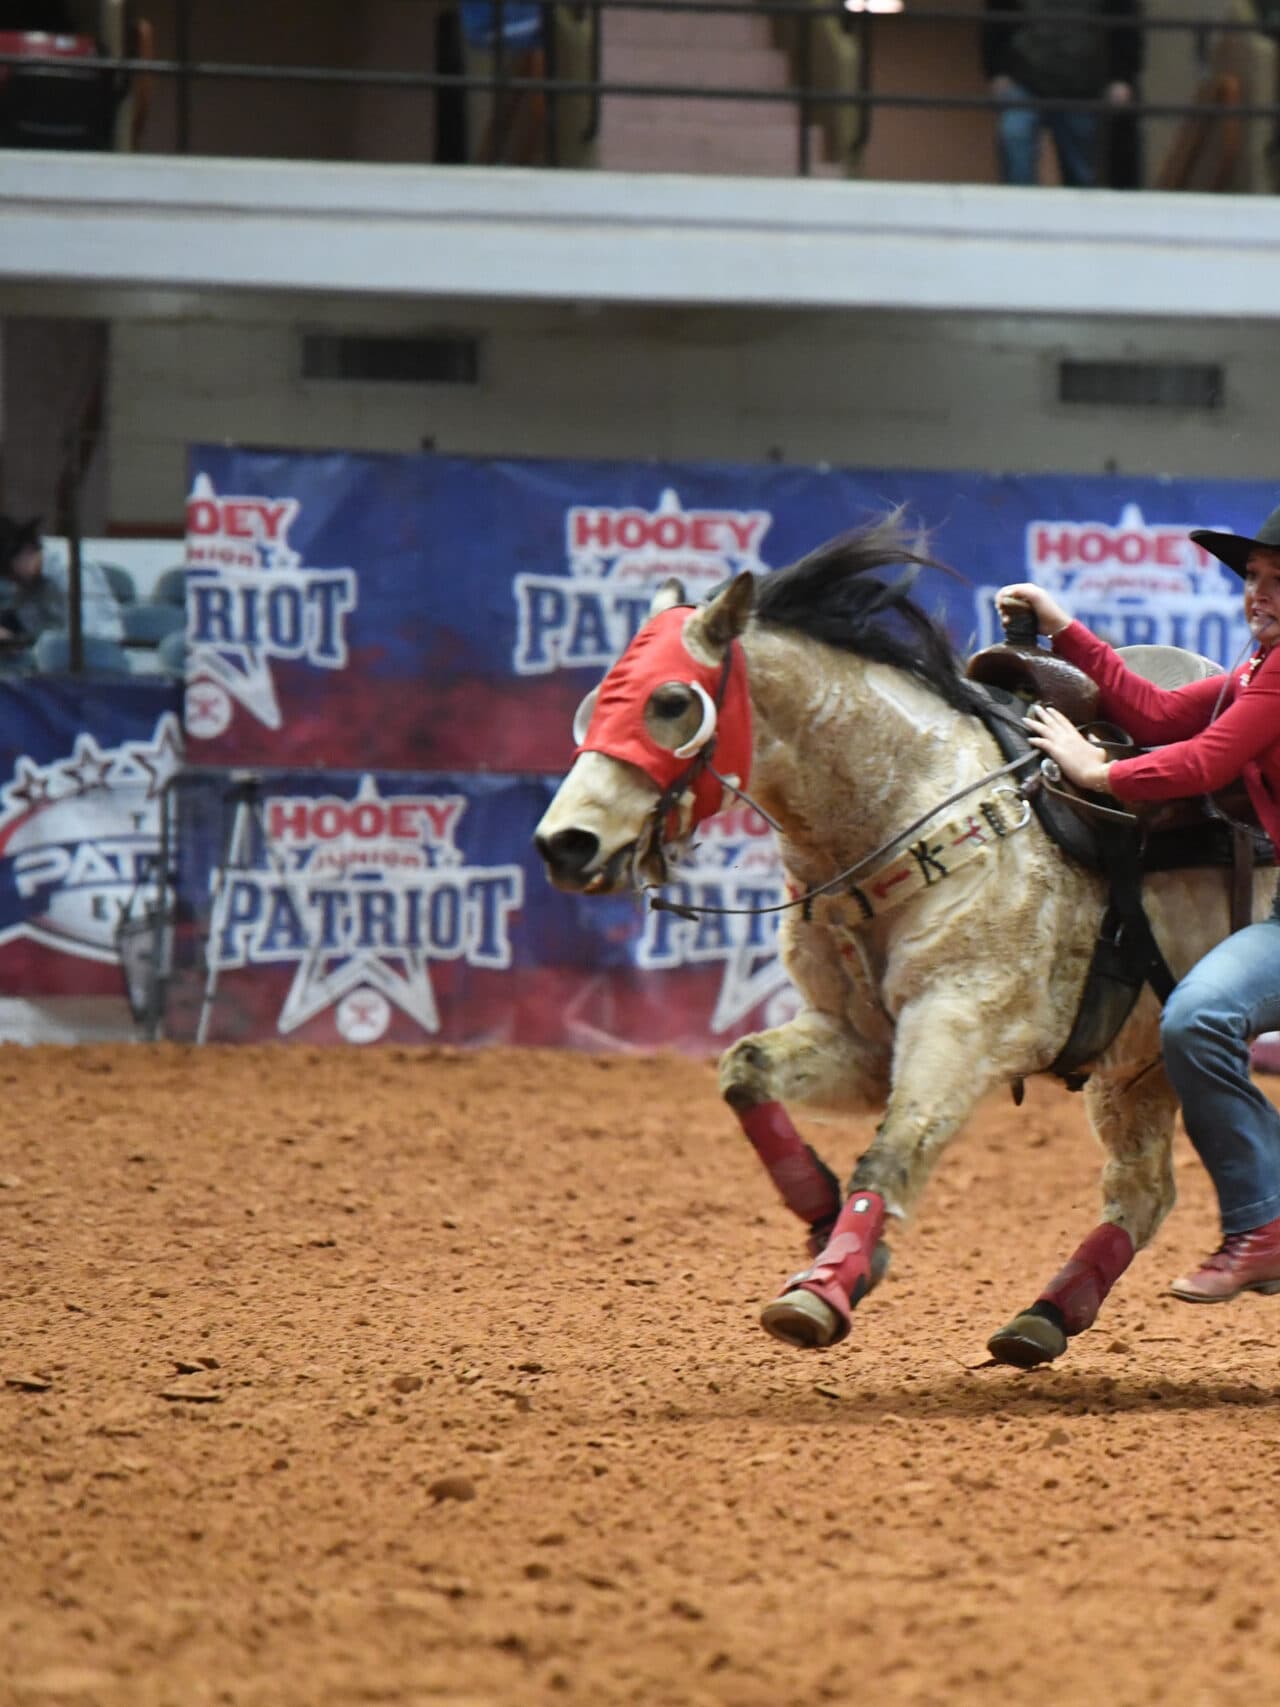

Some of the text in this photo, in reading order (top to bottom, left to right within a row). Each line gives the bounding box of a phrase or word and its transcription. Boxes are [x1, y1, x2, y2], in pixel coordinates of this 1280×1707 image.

[575, 514, 758, 551] HOOEY
[270, 803, 457, 840] HOOEY
[221, 876, 513, 957] PATRIOT
